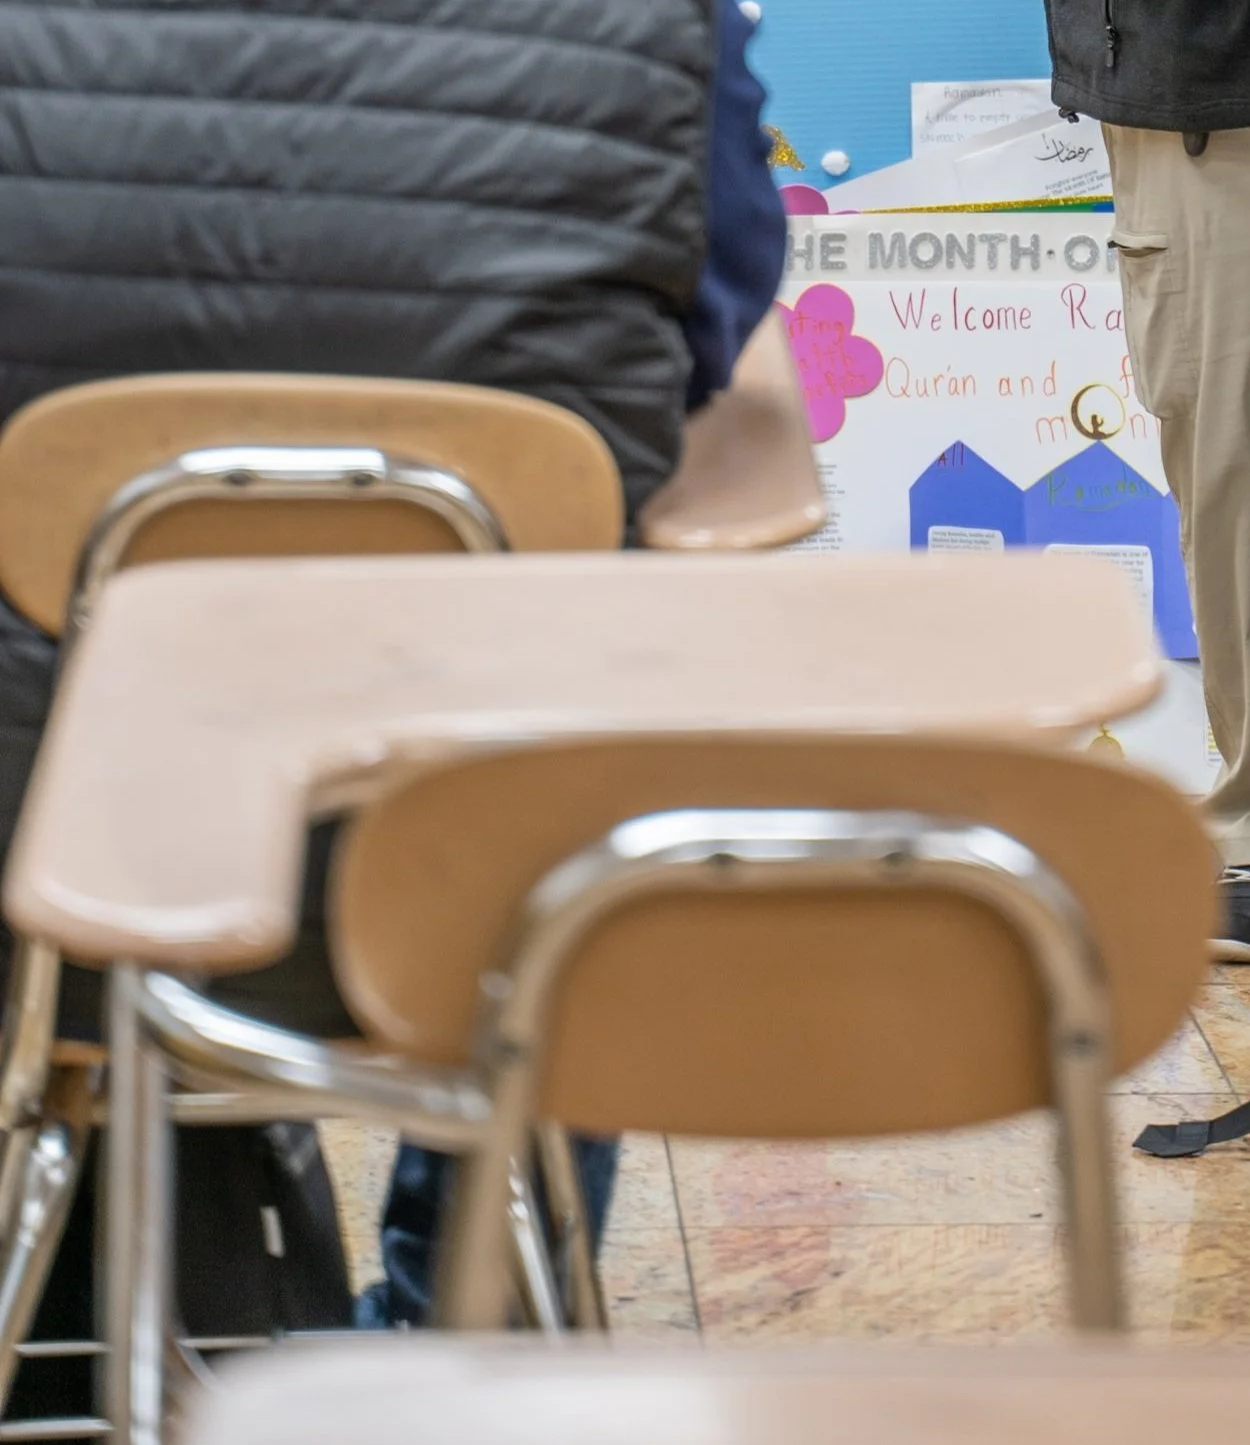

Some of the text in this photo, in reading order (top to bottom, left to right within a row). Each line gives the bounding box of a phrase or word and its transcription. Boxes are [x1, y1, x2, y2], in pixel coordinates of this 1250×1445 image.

[867, 232, 1042, 272] MONTH
[889, 287, 1033, 331] Welcome
[997, 359, 1056, 398] and
